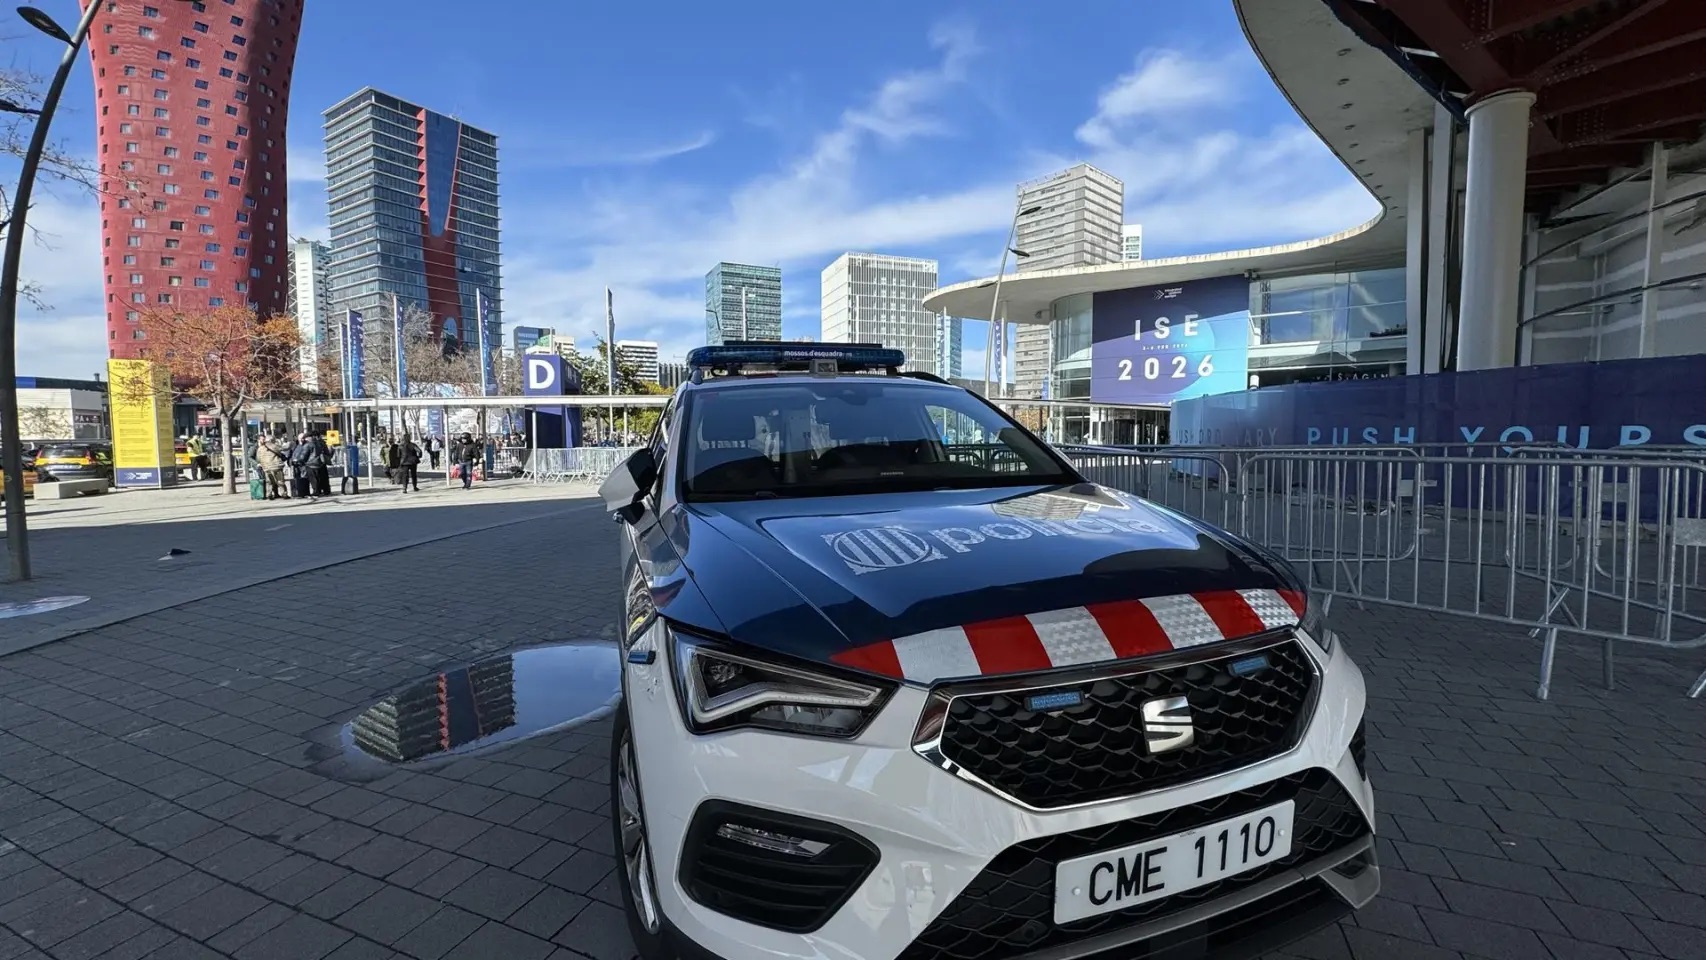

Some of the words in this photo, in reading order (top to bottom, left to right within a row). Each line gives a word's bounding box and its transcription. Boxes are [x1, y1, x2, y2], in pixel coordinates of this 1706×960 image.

[1134, 314, 1200, 341] ISE
[529, 359, 555, 389] D
[1118, 354, 1214, 381] 2026
[1307, 427, 1416, 446] PUSH
[1088, 846, 1168, 906] CME
[1194, 816, 1276, 879] 1110
